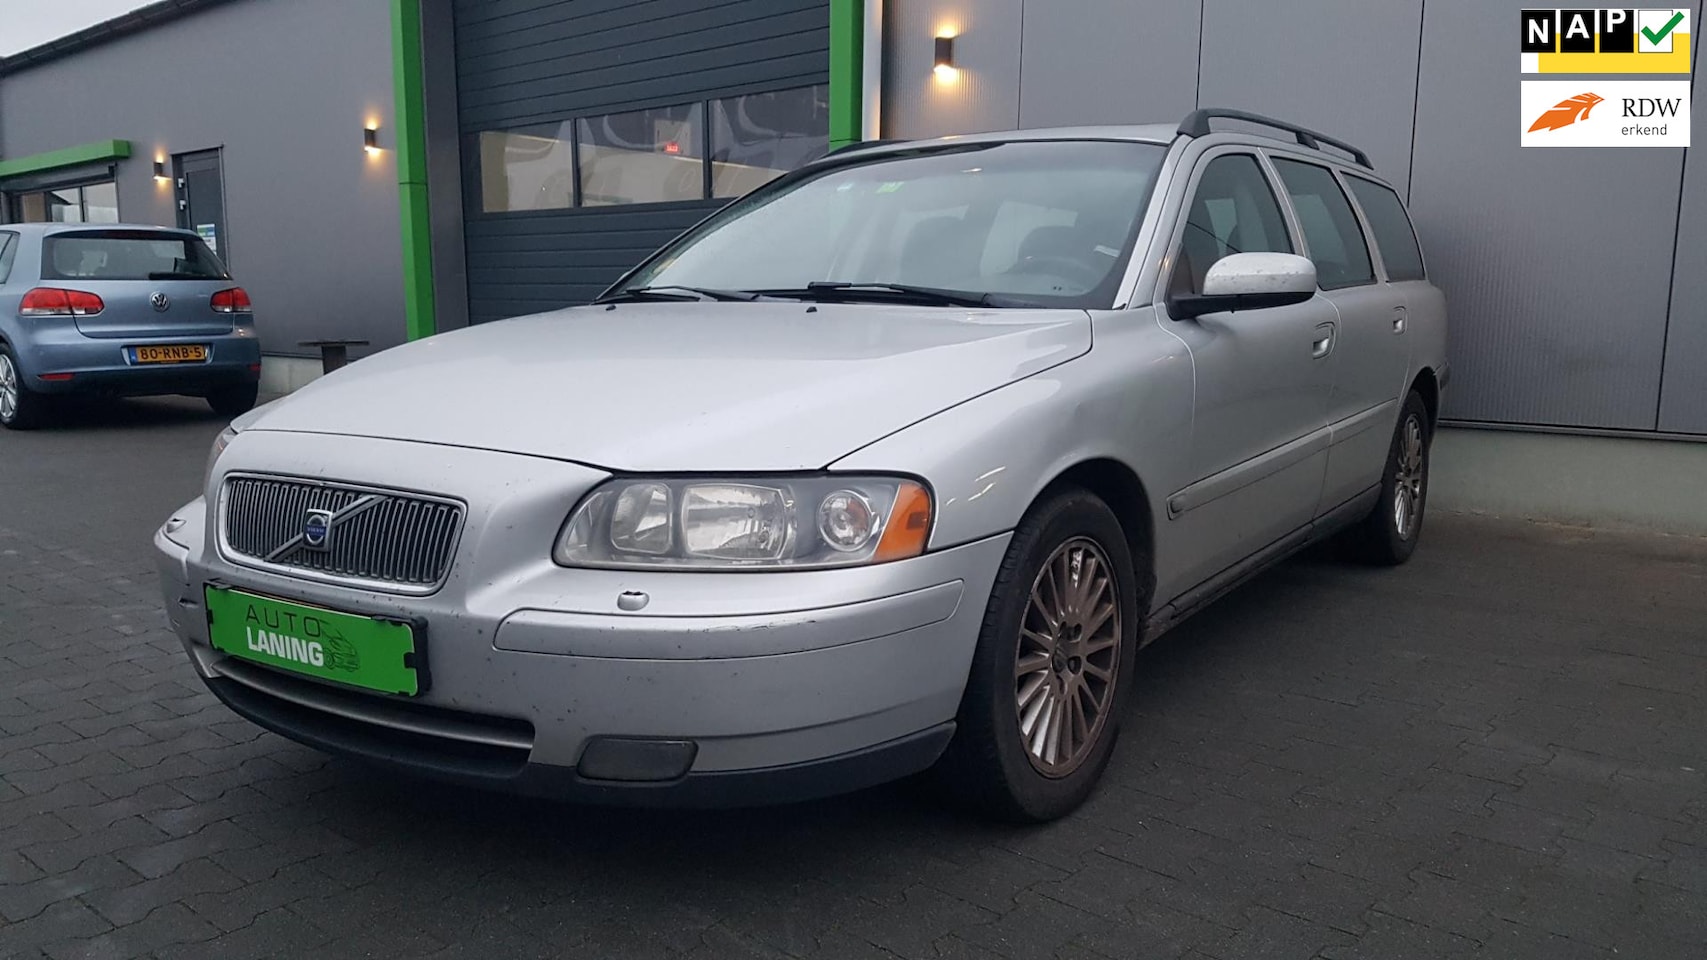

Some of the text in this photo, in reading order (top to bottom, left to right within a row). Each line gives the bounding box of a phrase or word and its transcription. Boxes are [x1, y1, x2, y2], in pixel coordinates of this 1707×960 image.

[140, 347, 202, 360] 80-RNB-5
[245, 604, 321, 638] AUTO
[246, 626, 324, 667] LANING
